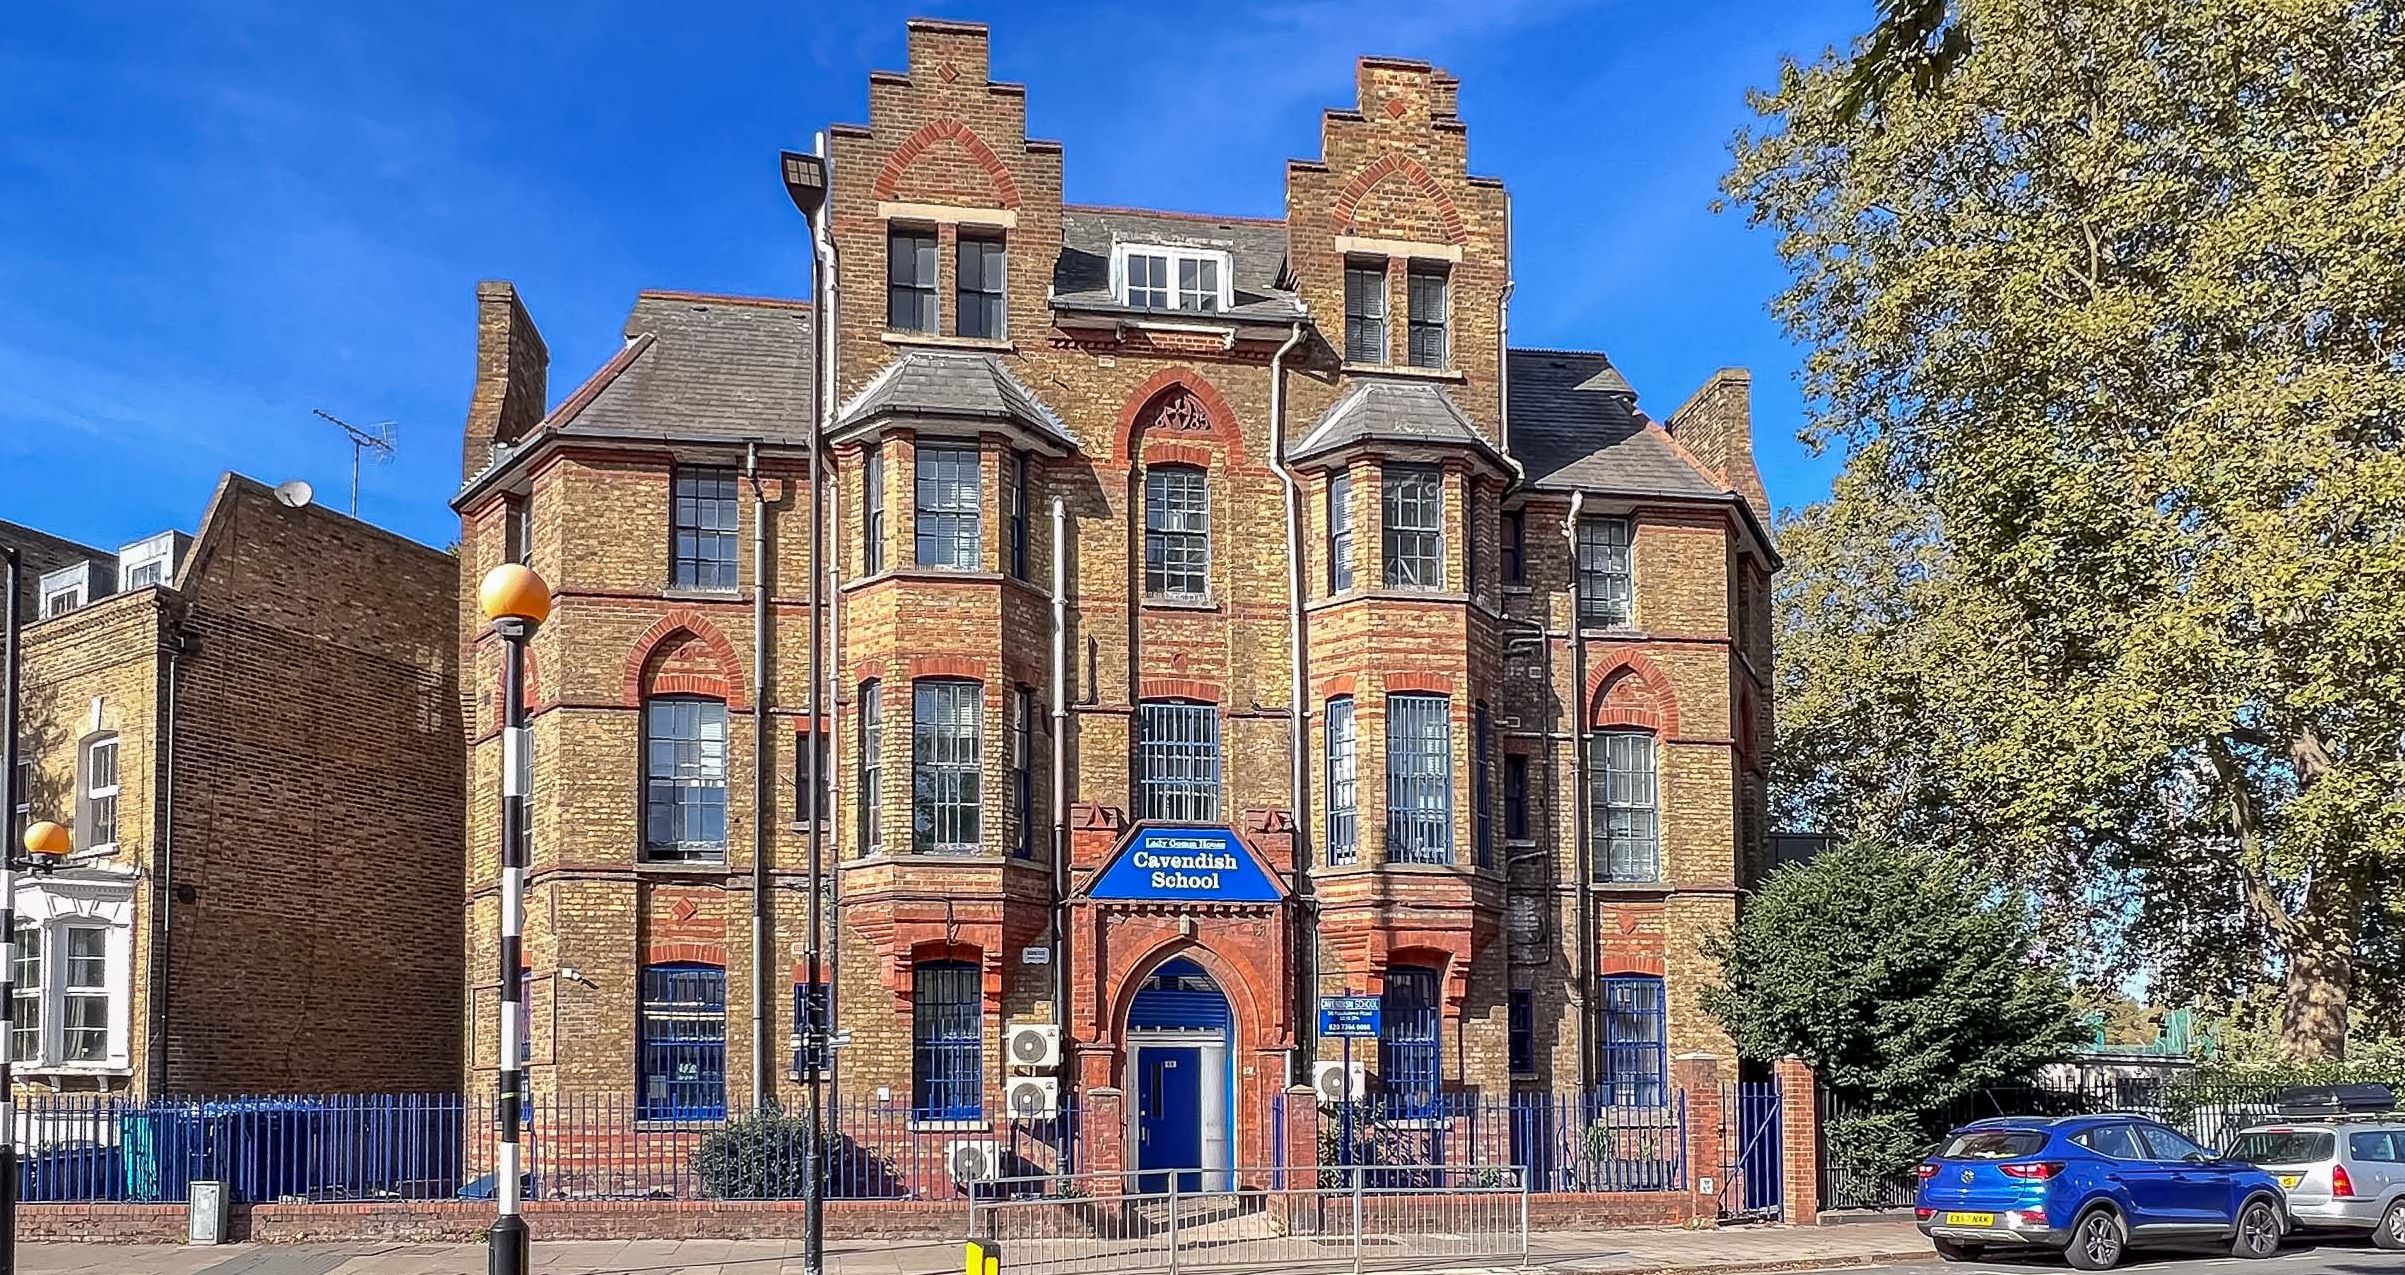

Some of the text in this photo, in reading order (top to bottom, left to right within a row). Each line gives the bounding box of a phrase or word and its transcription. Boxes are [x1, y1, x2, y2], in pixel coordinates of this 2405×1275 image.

[1146, 838, 1167, 848] Lady
[1133, 852, 1237, 870] Cavendish
[1151, 871, 1220, 889] School
